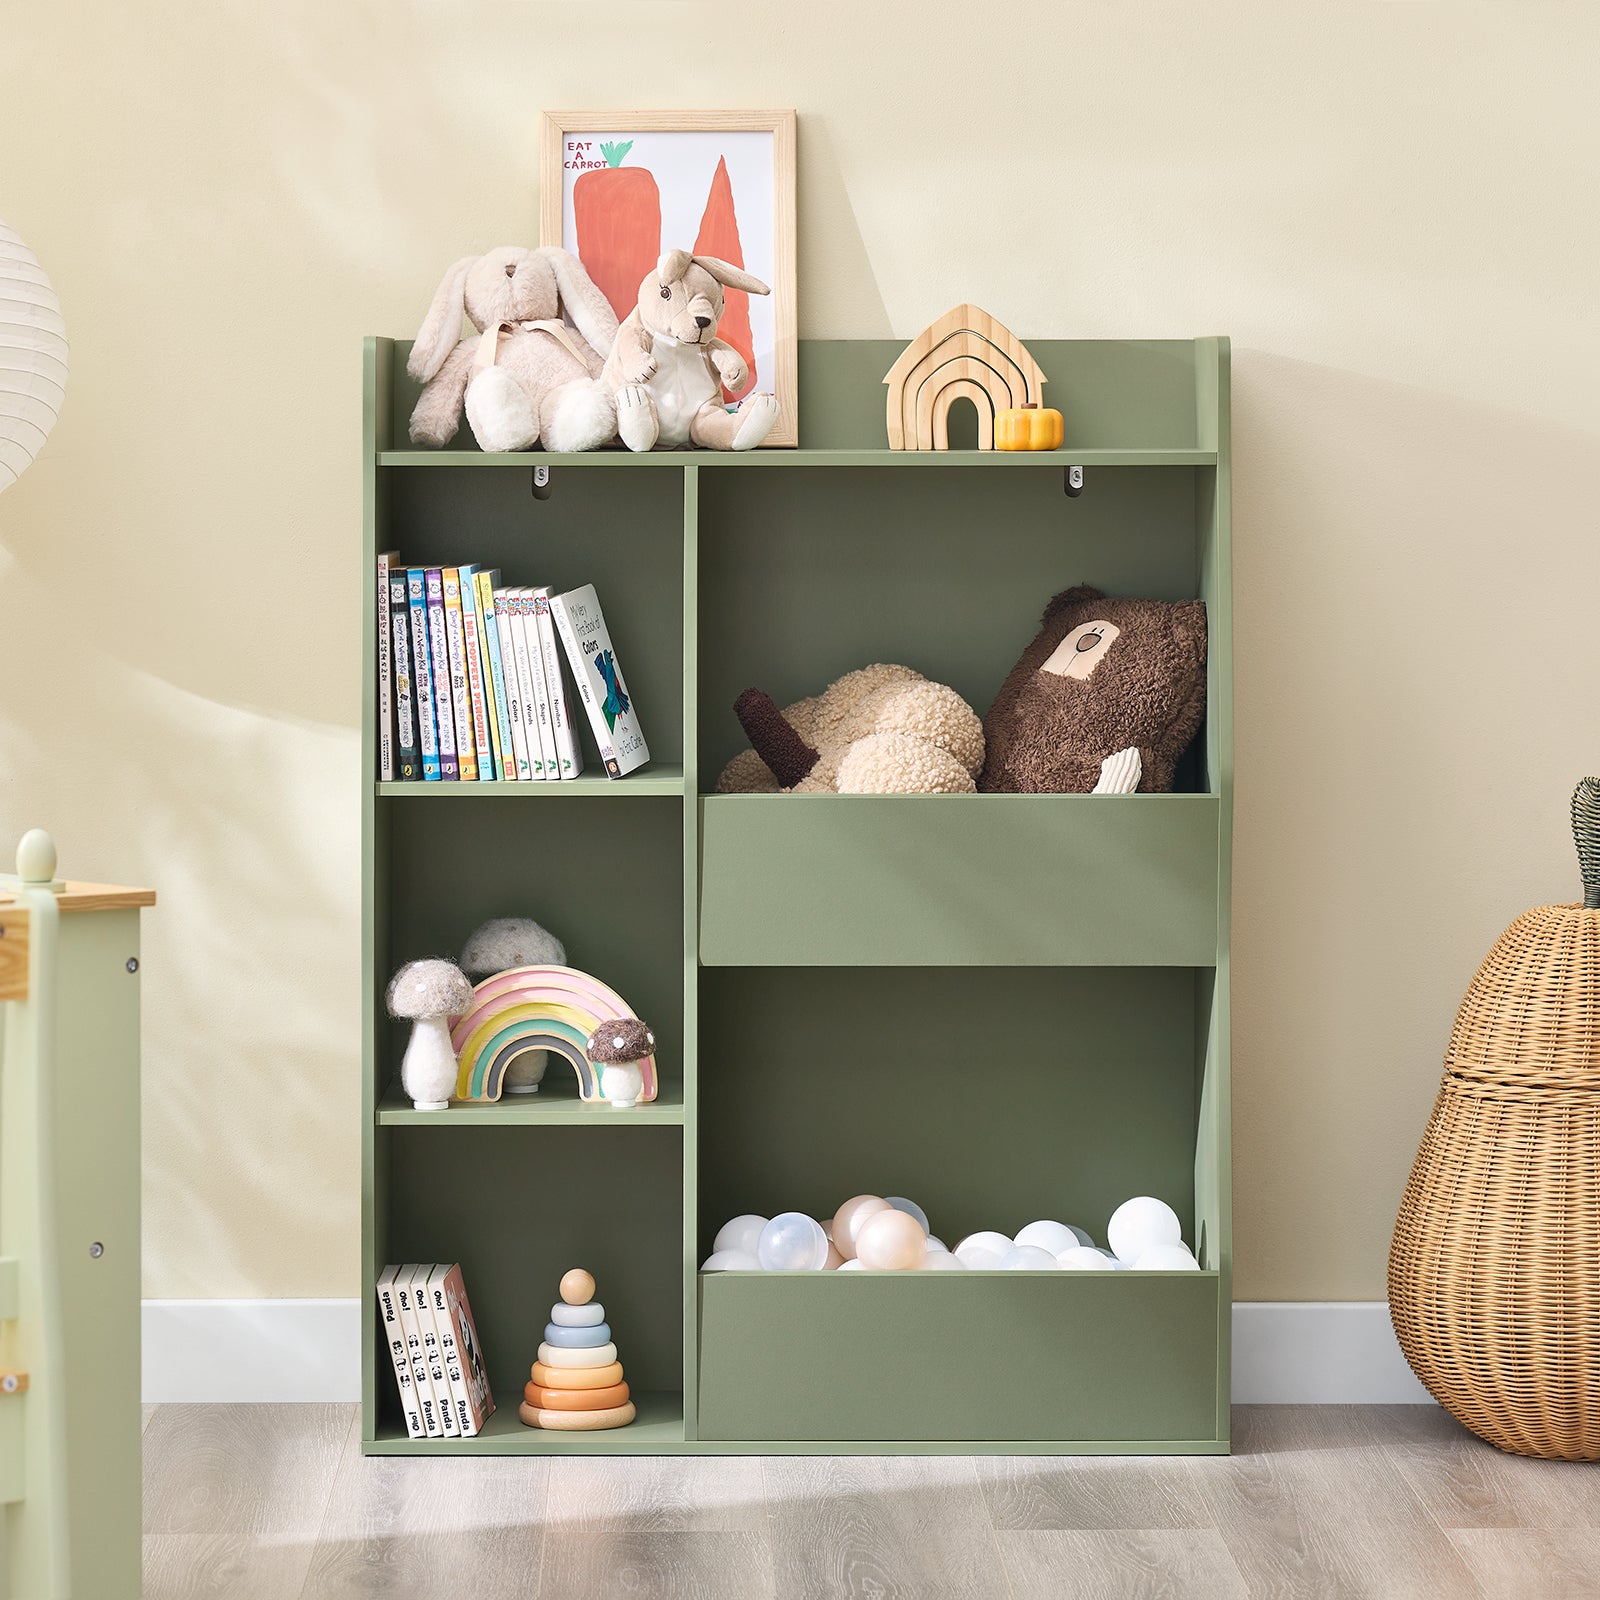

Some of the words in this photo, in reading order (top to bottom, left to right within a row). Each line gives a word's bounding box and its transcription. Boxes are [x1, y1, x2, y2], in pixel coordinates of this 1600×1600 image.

[568, 142, 592, 150] EAT
[575, 151, 584, 160] A
[564, 160, 608, 170] CARROT
[526, 597, 534, 615] ERIC
[540, 596, 548, 614] ERIC
[396, 618, 404, 636] Diary
[414, 608, 422, 628] Diary
[450, 610, 458, 629] Diary
[433, 608, 441, 626] Diary
[438, 660, 446, 670] Kid
[466, 620, 474, 640] MR.
[416, 639, 424, 659] Wimpy
[452, 640, 460, 660] Wimpy
[582, 640, 599, 655] Colors
[418, 660, 426, 670] Kid
[454, 660, 462, 671] Kid
[468, 641, 480, 690] POPPER'S
[582, 684, 590, 703] Colors
[422, 704, 430, 724] JEFF
[474, 692, 486, 748] PENGUINS
[460, 726, 468, 752] KINNEY
[622, 739, 633, 754] Eric
[630, 734, 643, 750] Carle
[382, 1292, 395, 1322] Panda
[399, 1291, 410, 1311] Oho!
[416, 1290, 427, 1309] Oho!
[434, 1291, 445, 1310] Oho!
[408, 1412, 420, 1431] Oho!
[423, 1400, 435, 1431] Panda
[440, 1399, 452, 1429] Panda
[458, 1400, 470, 1430] Panda
